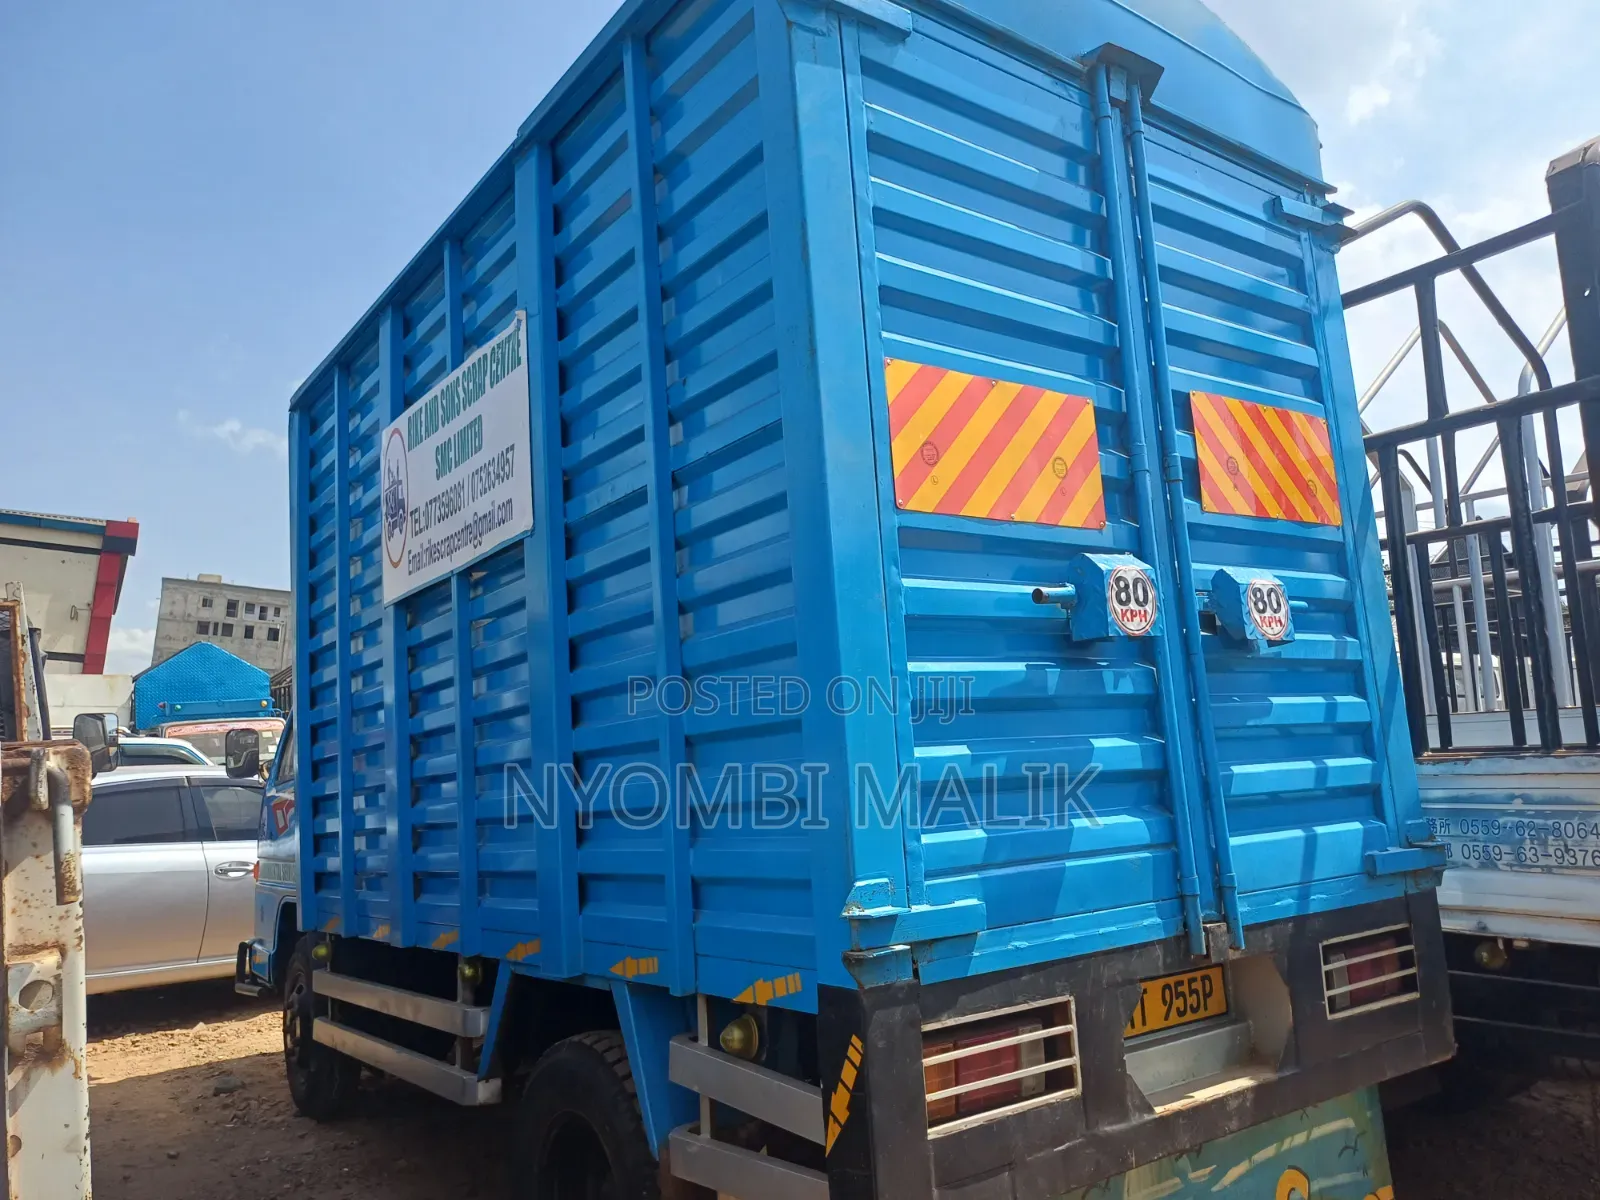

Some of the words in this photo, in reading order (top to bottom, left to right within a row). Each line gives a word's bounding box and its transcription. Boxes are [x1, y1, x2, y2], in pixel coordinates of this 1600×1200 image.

[408, 406, 424, 453] RIKE
[424, 394, 440, 441] AND
[440, 376, 461, 429] SONS
[461, 352, 488, 412] SCRAP
[489, 328, 522, 389] CENTRE
[435, 437, 453, 481] SMC
[453, 414, 483, 469] LIMITED
[471, 443, 516, 503] 0752634957
[1114, 575, 1149, 608] 80
[1251, 587, 1282, 615] 80
[1120, 608, 1148, 623] KPH
[1259, 615, 1283, 628] KPH
[1161, 974, 1214, 1022] 955P
